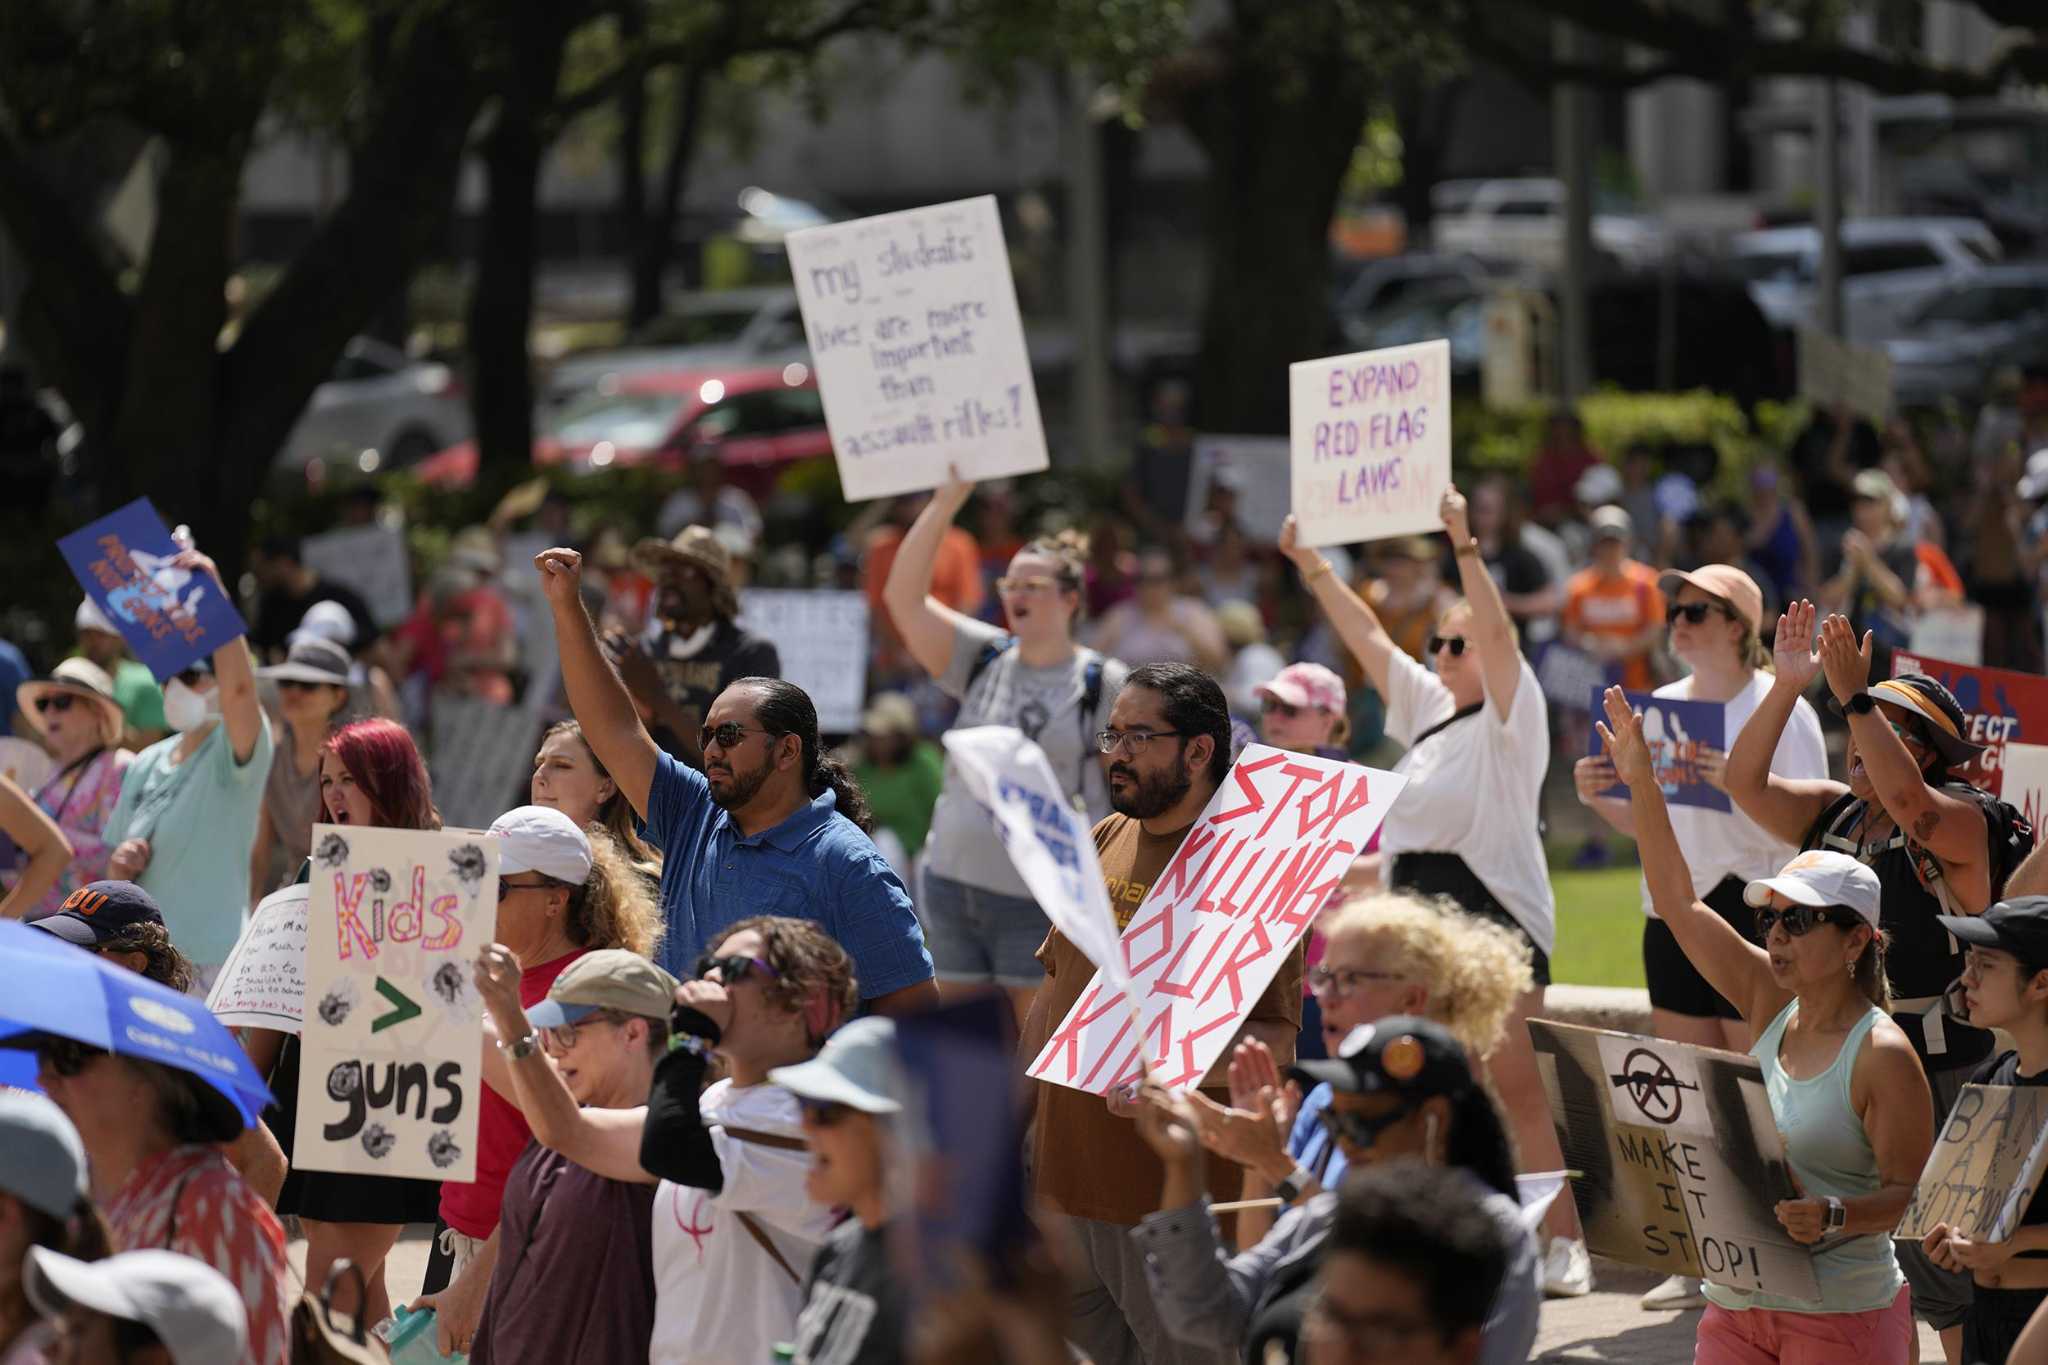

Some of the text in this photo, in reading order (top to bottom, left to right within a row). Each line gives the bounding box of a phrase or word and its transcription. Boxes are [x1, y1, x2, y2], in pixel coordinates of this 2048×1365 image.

[877, 229, 974, 277] students
[812, 301, 987, 352] lives are more
[878, 374, 934, 401] than
[1329, 360, 1421, 407] EXPAND
[842, 413, 937, 459] assault
[1314, 407, 1428, 462] RED FLAG
[1338, 457, 1402, 504] LAWS
[1209, 753, 1369, 841] STOP
[335, 865, 463, 960] Kids
[1150, 823, 1355, 948] KILLING
[1120, 903, 1273, 1011] OUR
[1034, 984, 1241, 1098] KIDS
[323, 1059, 463, 1141] guns
[1943, 1088, 2048, 1144] BAN
[1616, 1134, 1706, 1181] MAKE
[1656, 1182, 1707, 1218] IT
[1643, 1224, 1763, 1289] STOP!
